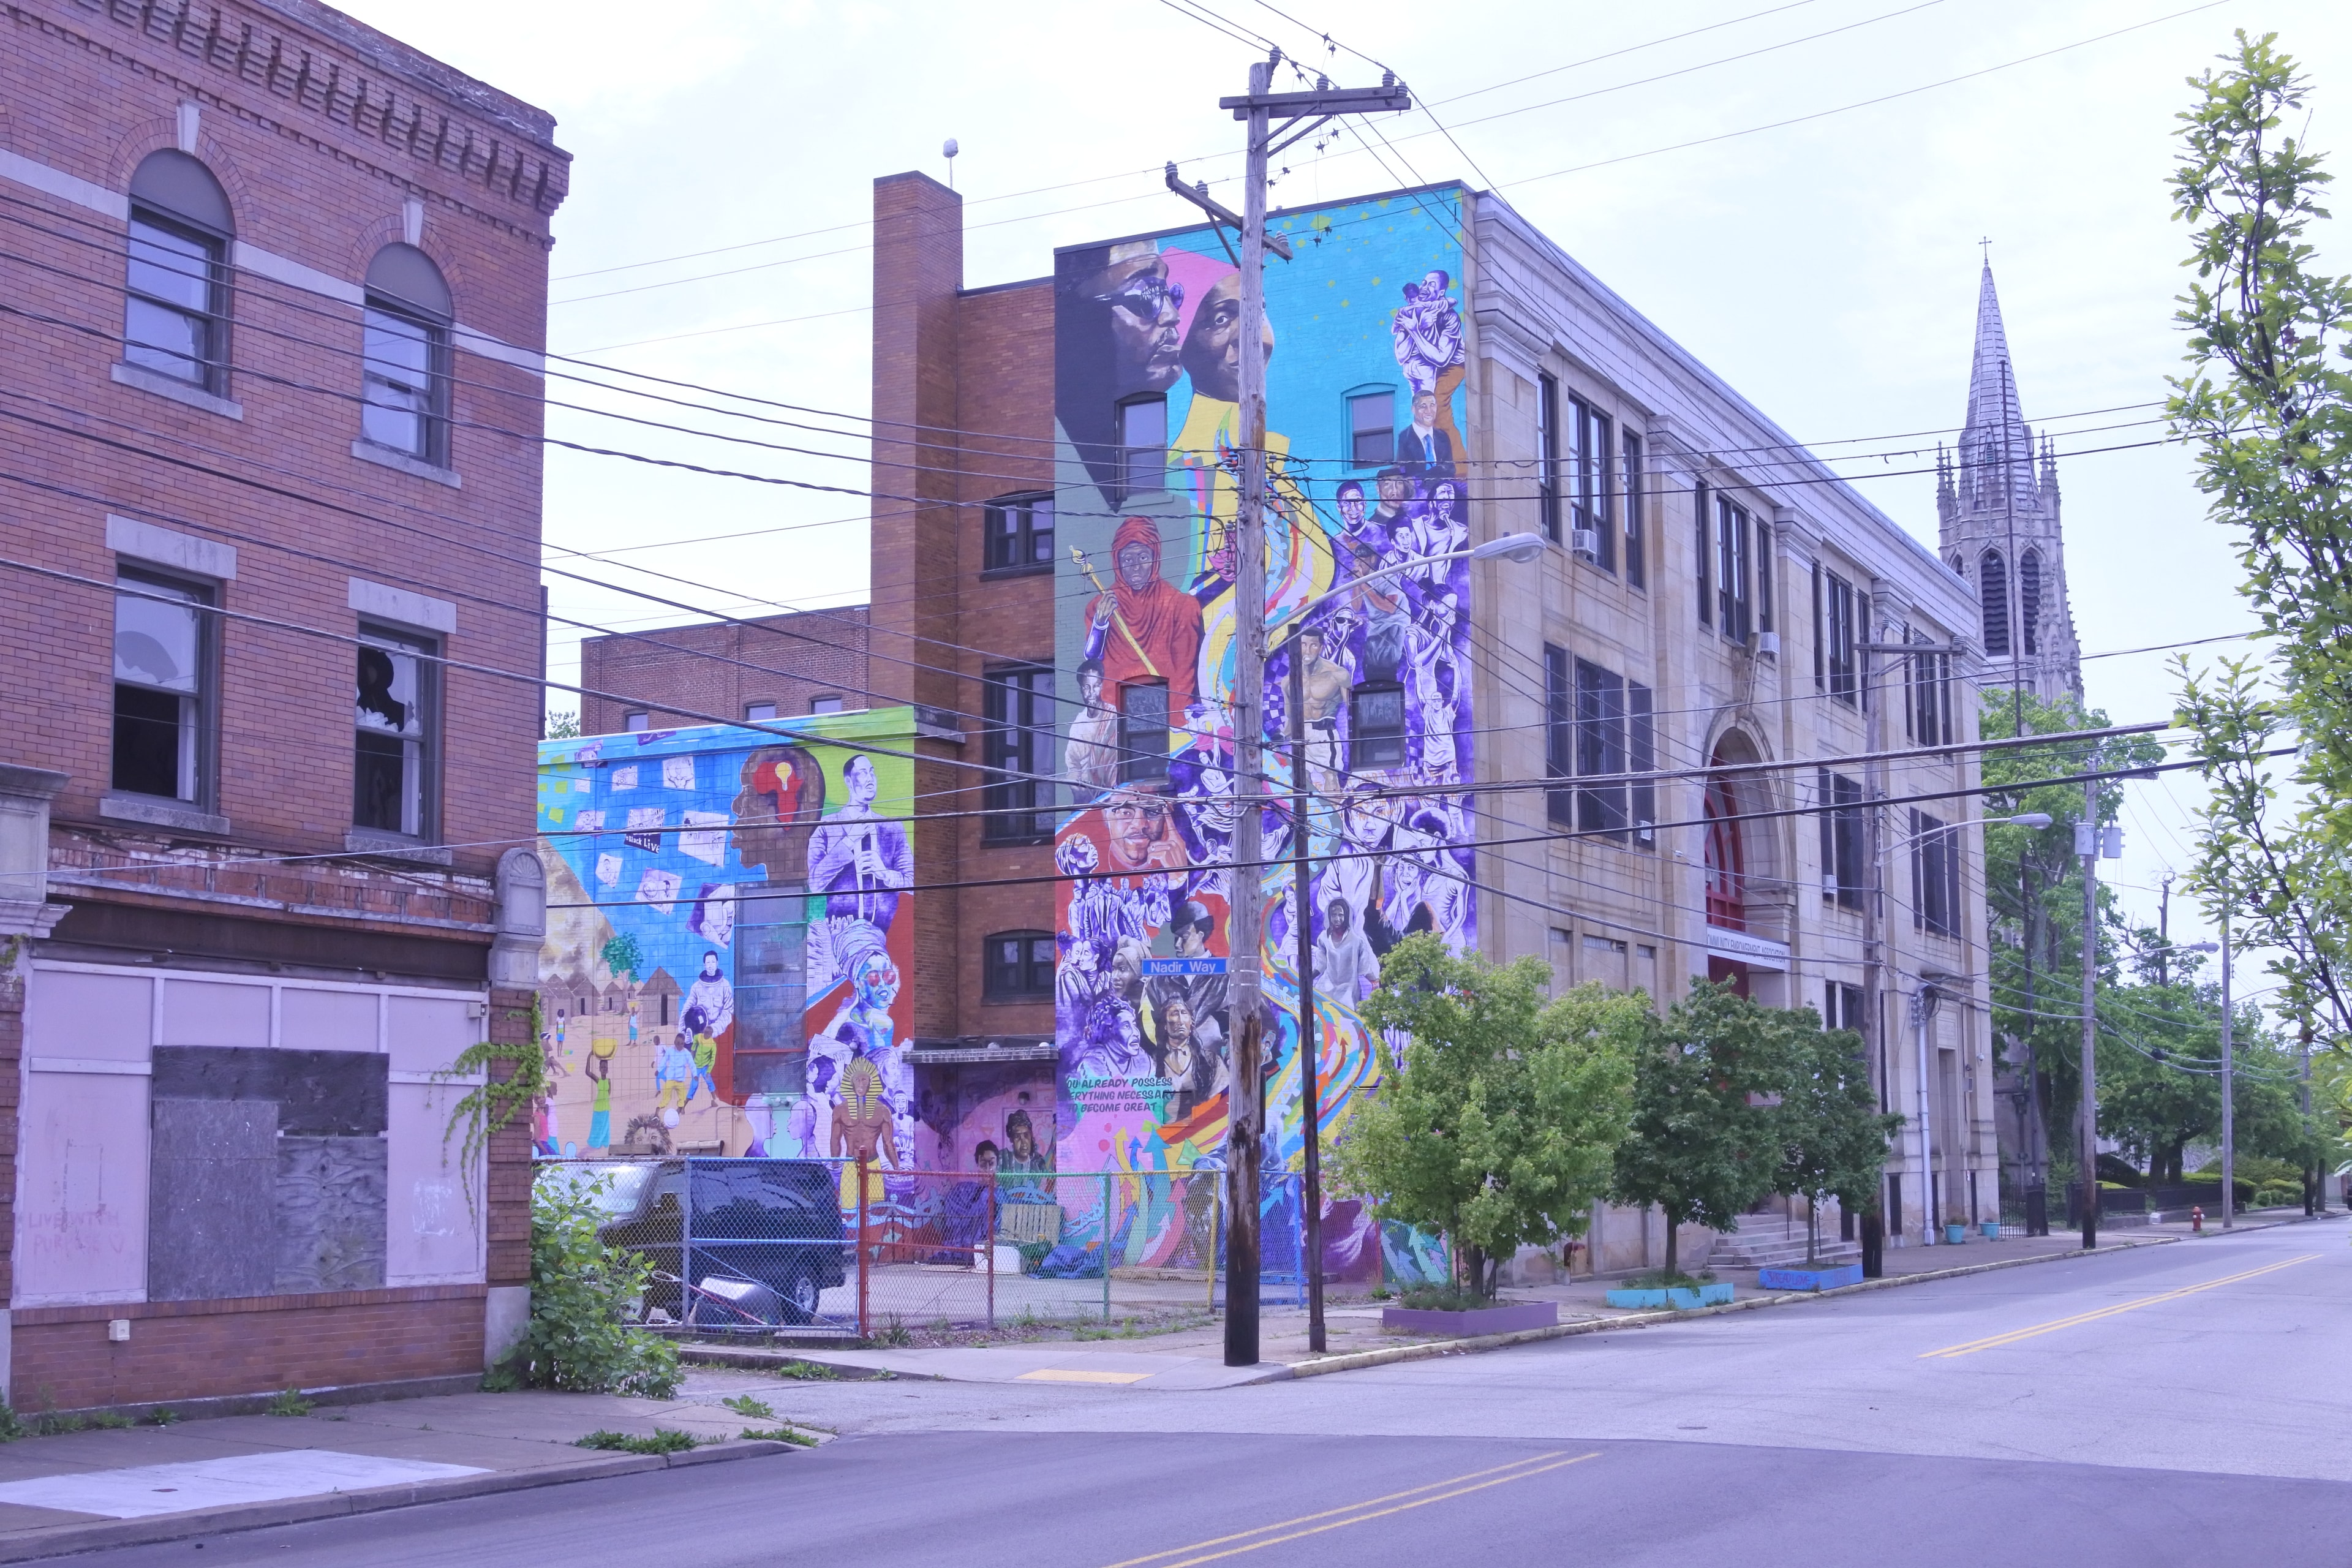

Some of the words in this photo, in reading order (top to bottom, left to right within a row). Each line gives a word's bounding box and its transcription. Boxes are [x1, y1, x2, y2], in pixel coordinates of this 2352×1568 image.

[628, 835, 642, 845] Black
[1707, 933, 1731, 949] OMMUNITY
[1151, 961, 1183, 973] Nadir
[1189, 960, 1216, 974] Way
[1066, 1075, 1079, 1088] OU
[1081, 1078, 1129, 1088] ALREADY
[1131, 1077, 1173, 1087] POSSESS
[1070, 1091, 1115, 1101] ERYTHING
[1117, 1089, 1176, 1101] NECESSARY
[1068, 1103, 1078, 1113] TO
[1080, 1103, 1121, 1113] BECOME
[1123, 1102, 1158, 1112] GREAT
